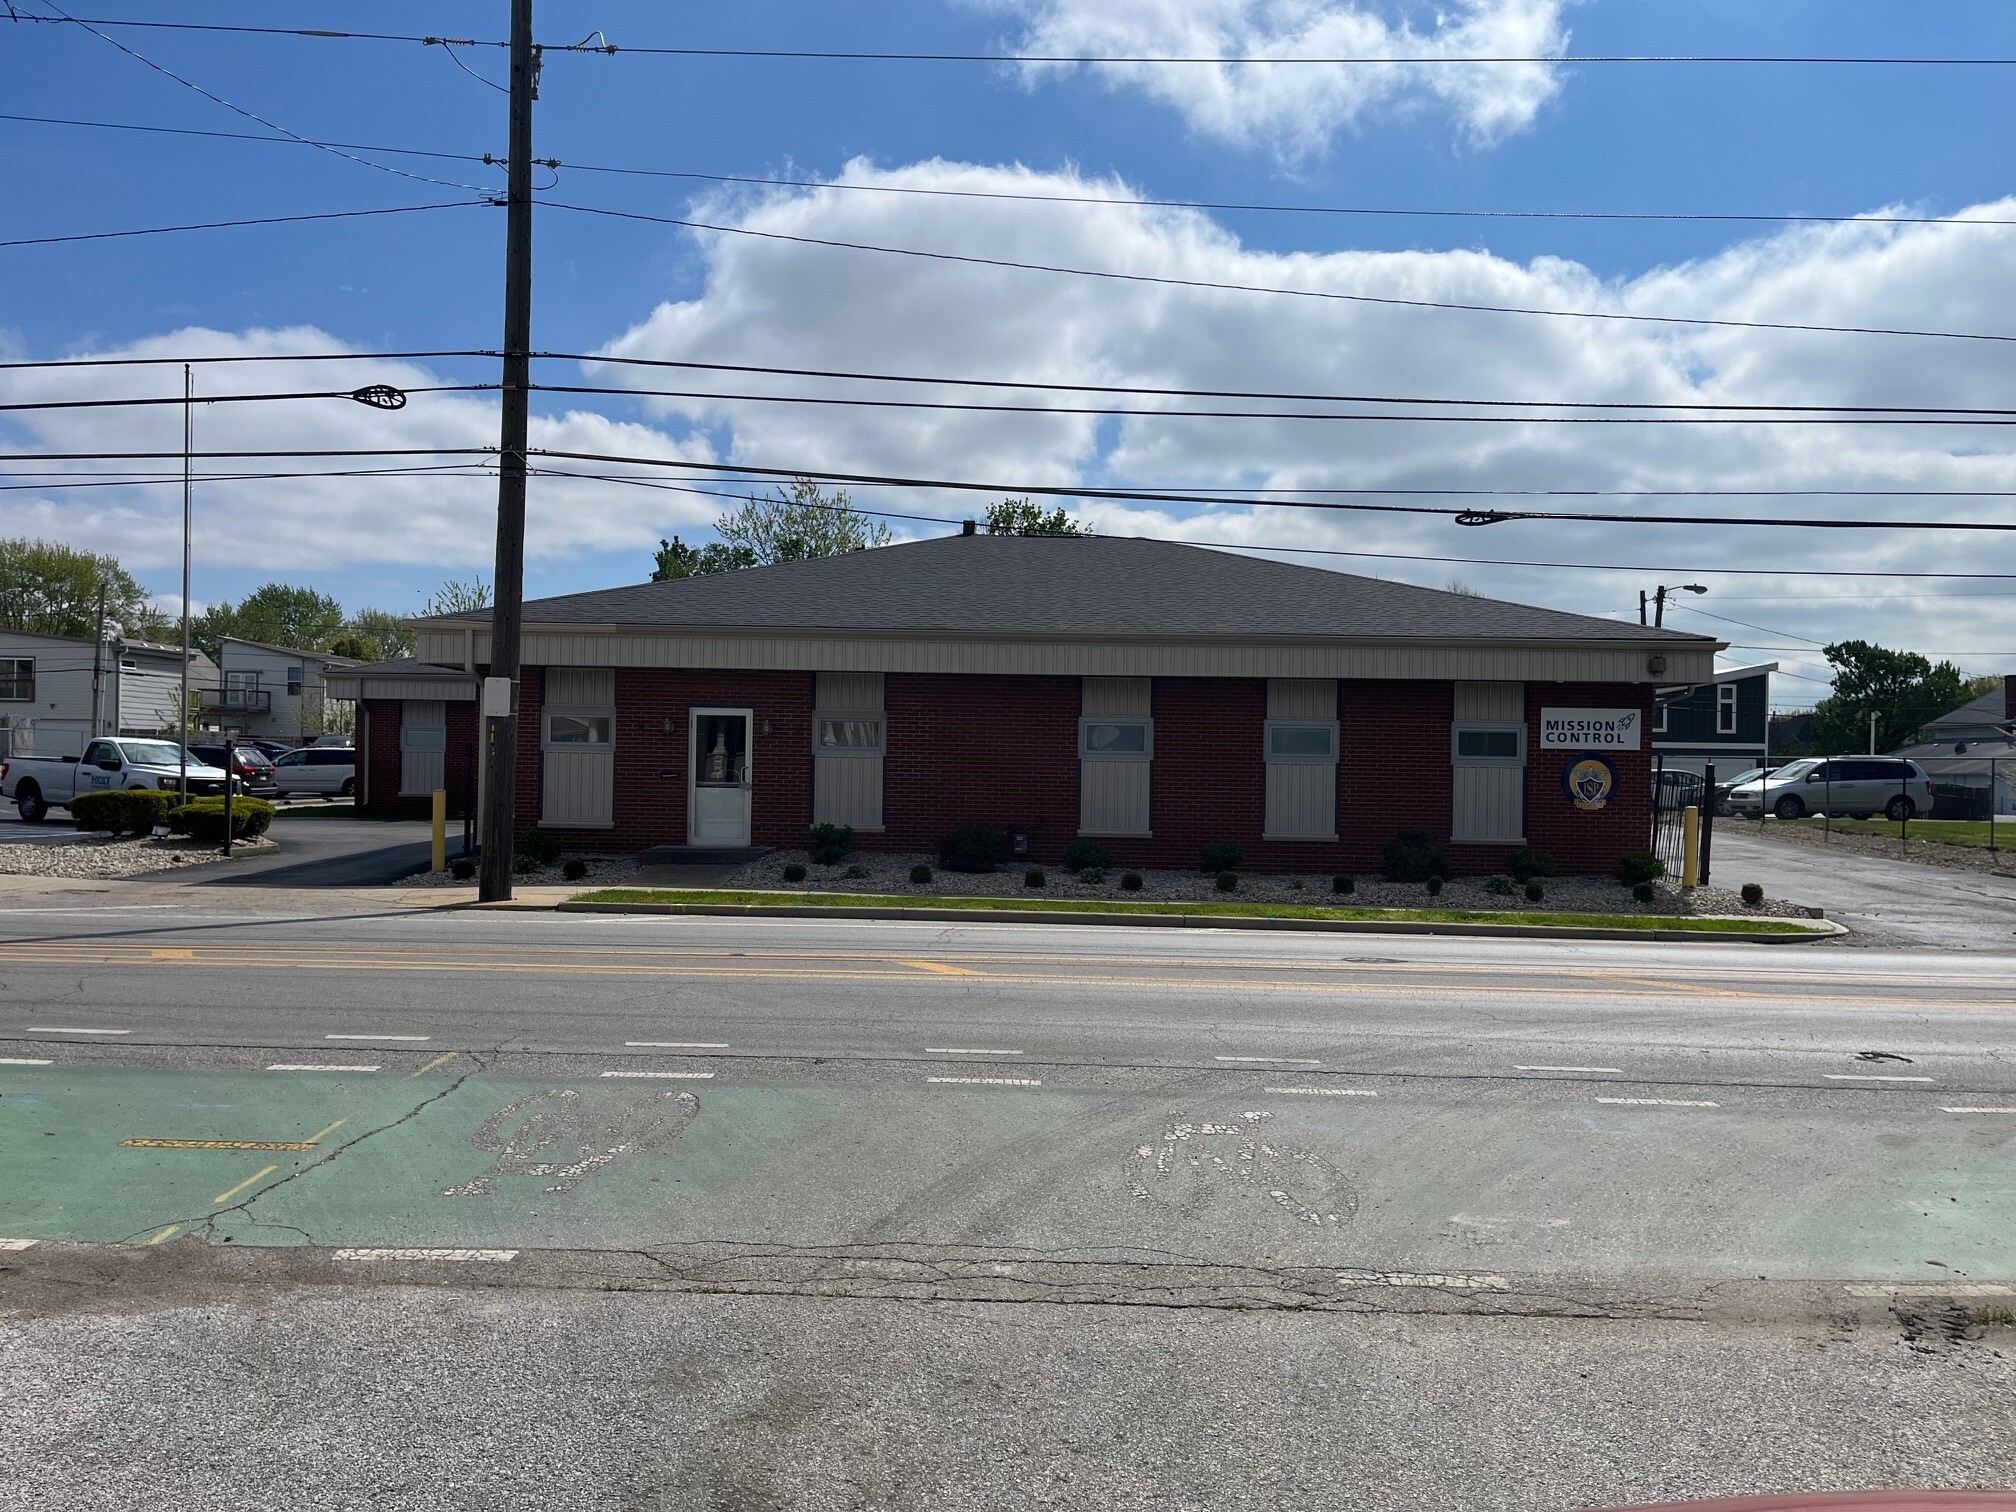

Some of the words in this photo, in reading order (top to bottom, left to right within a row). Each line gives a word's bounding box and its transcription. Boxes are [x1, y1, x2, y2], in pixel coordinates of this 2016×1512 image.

[1546, 720, 1615, 731] MISSION
[1546, 732, 1625, 744] CONTROL
[1583, 781, 1600, 796] ISP
